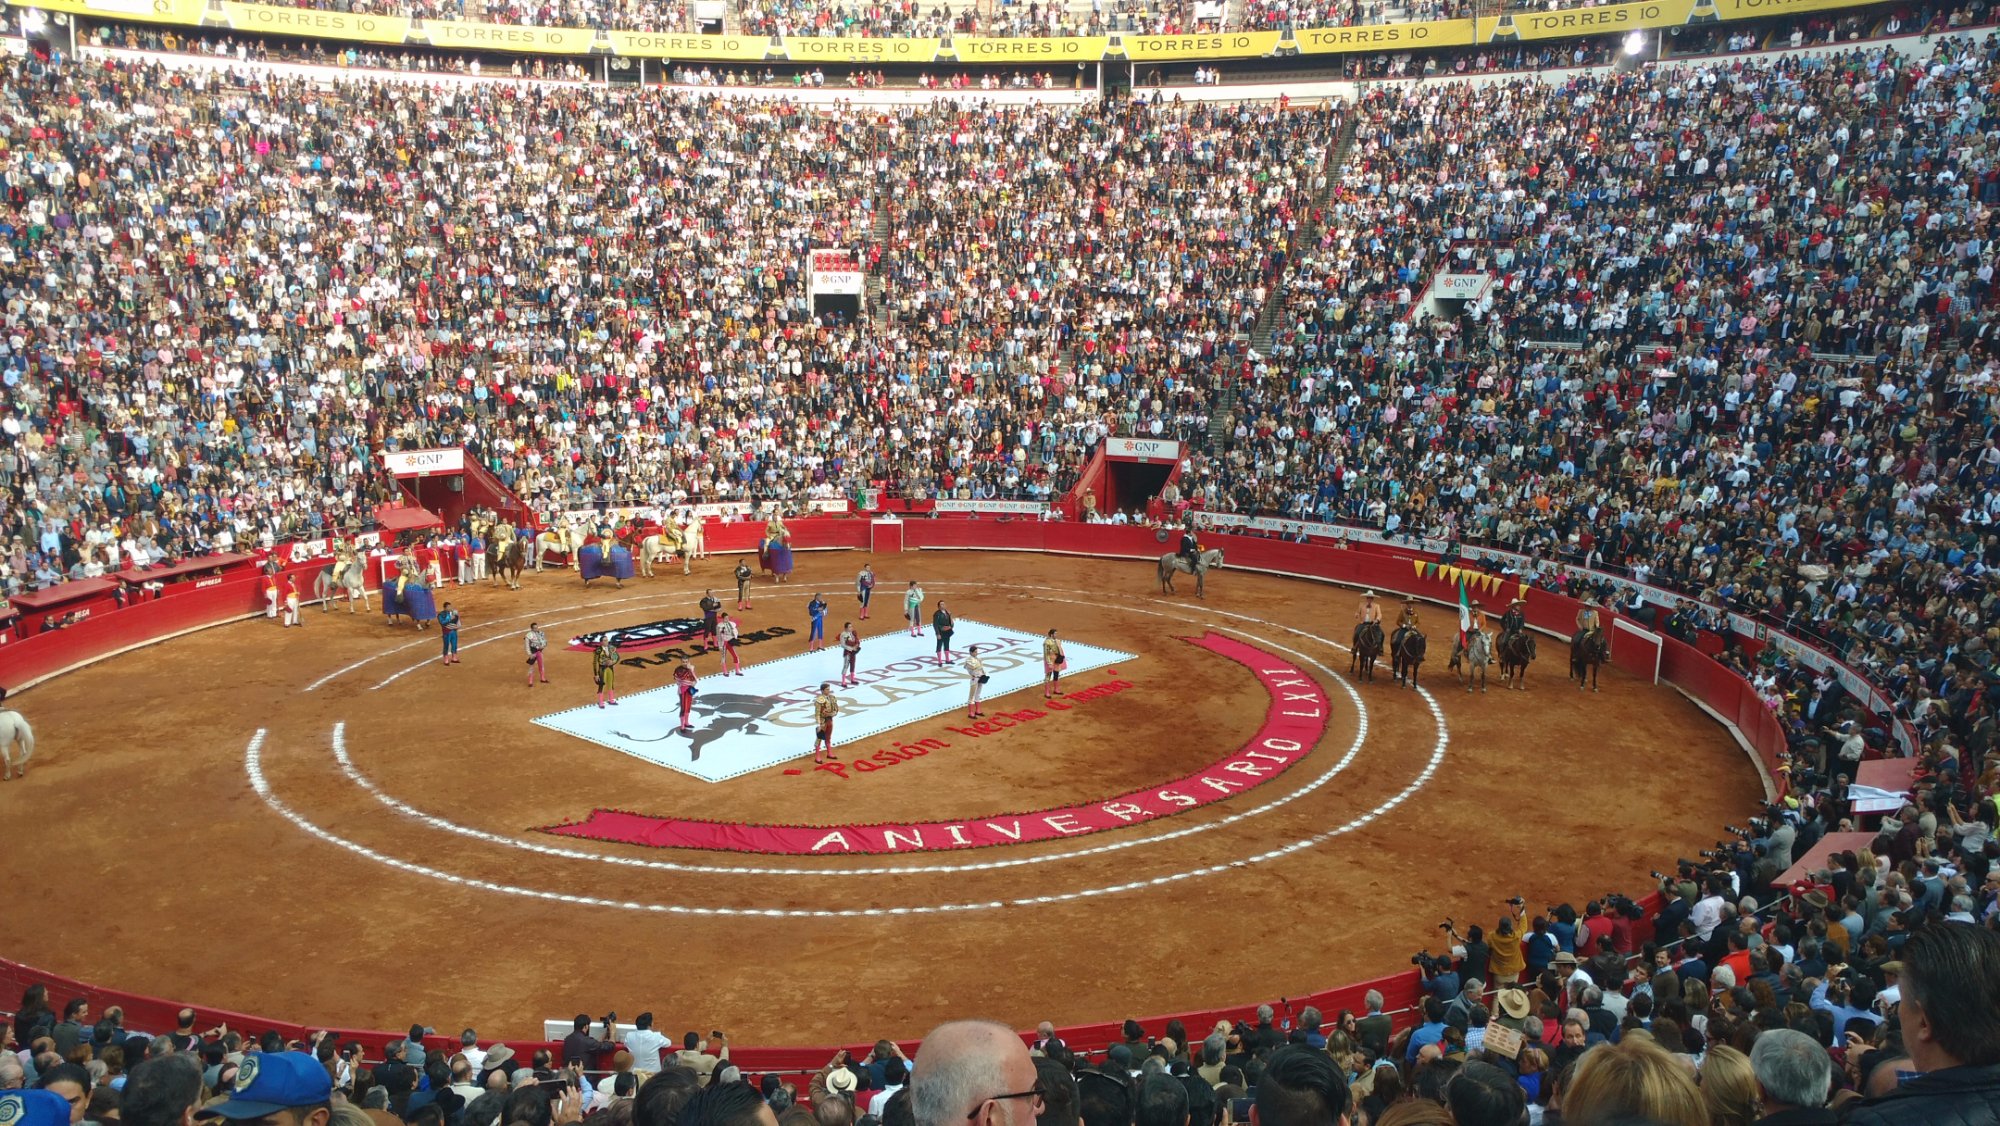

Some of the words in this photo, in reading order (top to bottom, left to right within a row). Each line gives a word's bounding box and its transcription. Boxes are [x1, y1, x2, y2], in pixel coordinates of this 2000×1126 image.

[244, 9, 344, 28] TORRES
[1530, 10, 1628, 29] TORRES
[442, 26, 534, 42] TORRES
[1310, 29, 1400, 44] TORRES
[625, 36, 712, 49] TORRES
[798, 42, 883, 53] TORRES
[968, 42, 1052, 53] TORRES
[1137, 38, 1222, 51] TORRES
[830, 275, 851, 283] GNP
[1454, 278, 1476, 287] GNP
[1135, 442, 1159, 452] GNP
[417, 454, 443, 465] GNP
[1328, 526, 1341, 534] GNP
[196, 577, 222, 588] EMPRESA
[761, 636, 1034, 706] TEMPORADA
[1262, 669, 1320, 718] LXXI
[1045, 700, 1072, 711] a
